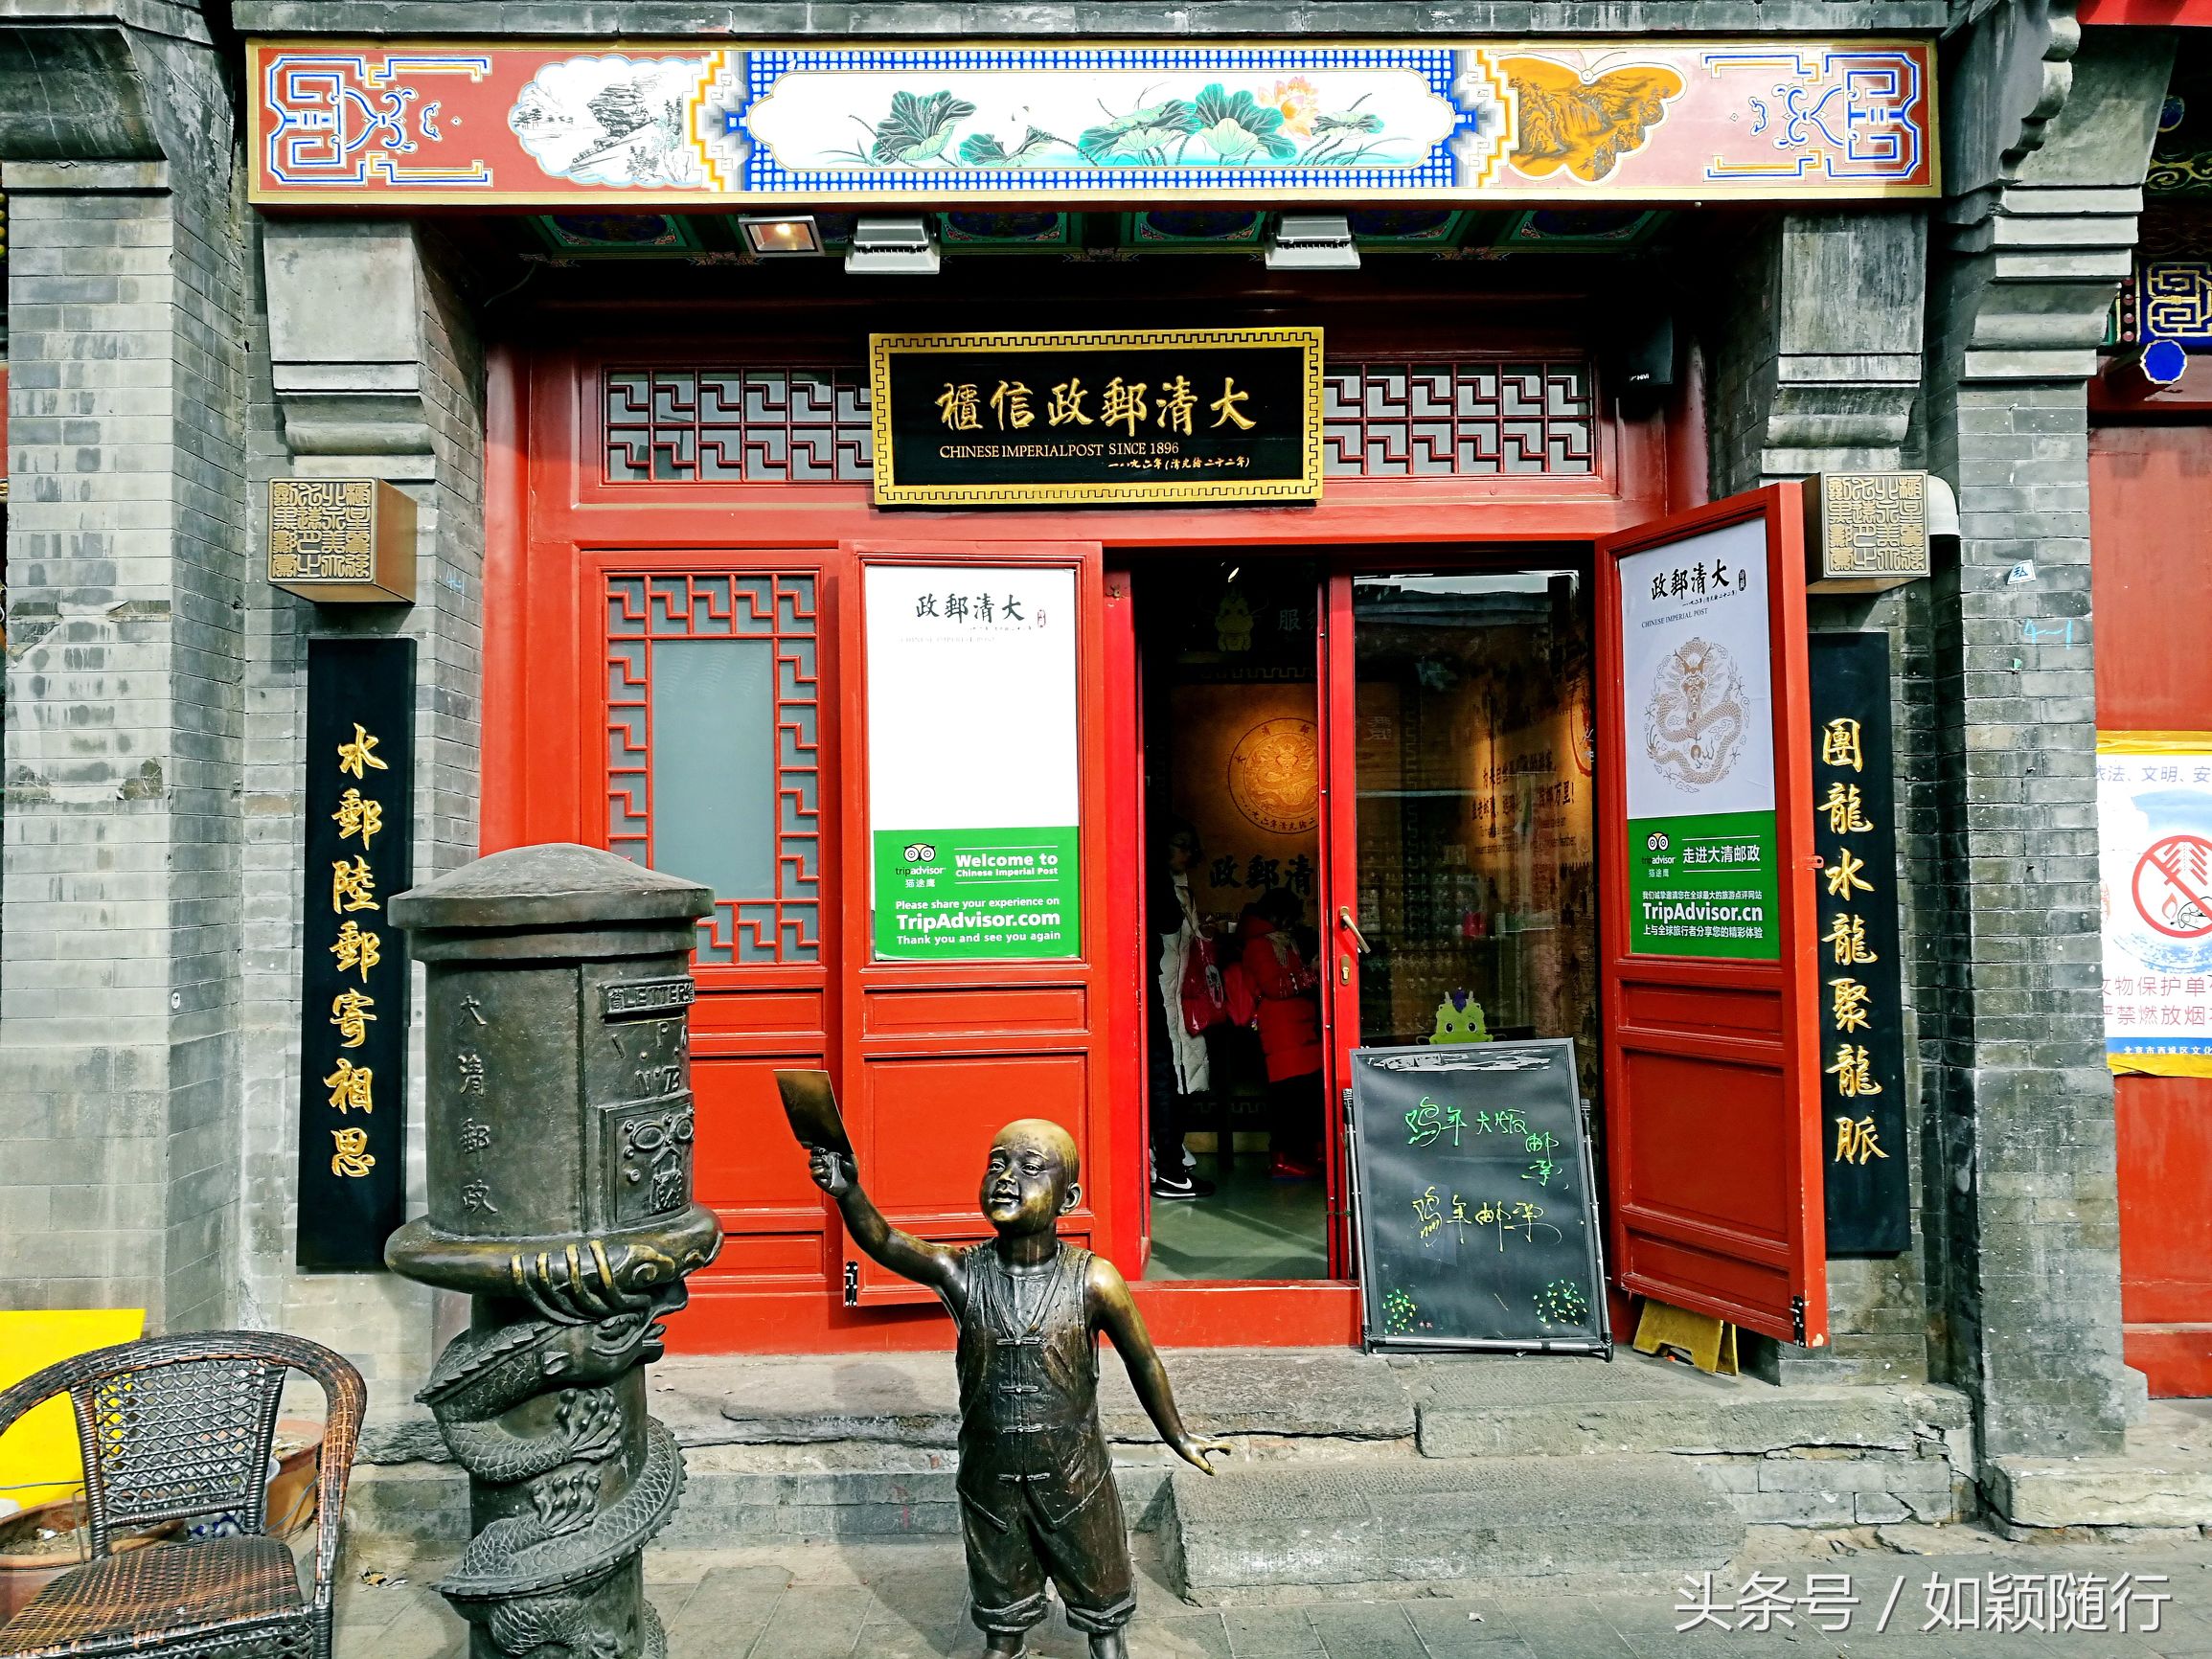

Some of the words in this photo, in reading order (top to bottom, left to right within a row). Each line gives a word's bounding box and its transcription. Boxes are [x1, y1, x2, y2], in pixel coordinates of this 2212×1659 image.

[940, 445, 999, 459] CHINESE
[1108, 443, 1147, 455] SINCE
[1150, 442, 1179, 455] 1896
[1652, 558, 1730, 601] 大清郵政
[916, 593, 1025, 625] 大清郵政
[1641, 617, 1665, 628] CHINESE
[1666, 611, 1693, 624] IMPERIAL
[1694, 607, 1709, 617] POST
[955, 853, 1034, 868] Welcome
[1039, 853, 1059, 865] to
[1682, 845, 1761, 864] 走进大清邮政
[896, 866, 944, 876] tripadvisor
[955, 868, 992, 877] Chinese
[995, 867, 1035, 877] Imperial
[1038, 867, 1059, 875] Post
[896, 900, 928, 910] Please
[931, 899, 959, 909] share
[962, 900, 986, 910] your
[989, 898, 1043, 909] experience
[1643, 901, 1763, 924] TripAdvisor.cn
[897, 911, 1060, 933] TripAdvisor.com
[1643, 924, 1764, 939] 上与全球旅行者分享您的精彩体验
[897, 935, 930, 944] Thank
[934, 936, 955, 945] you
[959, 933, 980, 943] and
[984, 933, 1002, 942] see
[1006, 933, 1026, 943] you
[1030, 931, 1060, 943] again
[323, 722, 389, 1178] 水郵陸郵寄相思
[2102, 975, 2212, 997] 物保护单
[2103, 1005, 2212, 1027] 禁燃放烟
